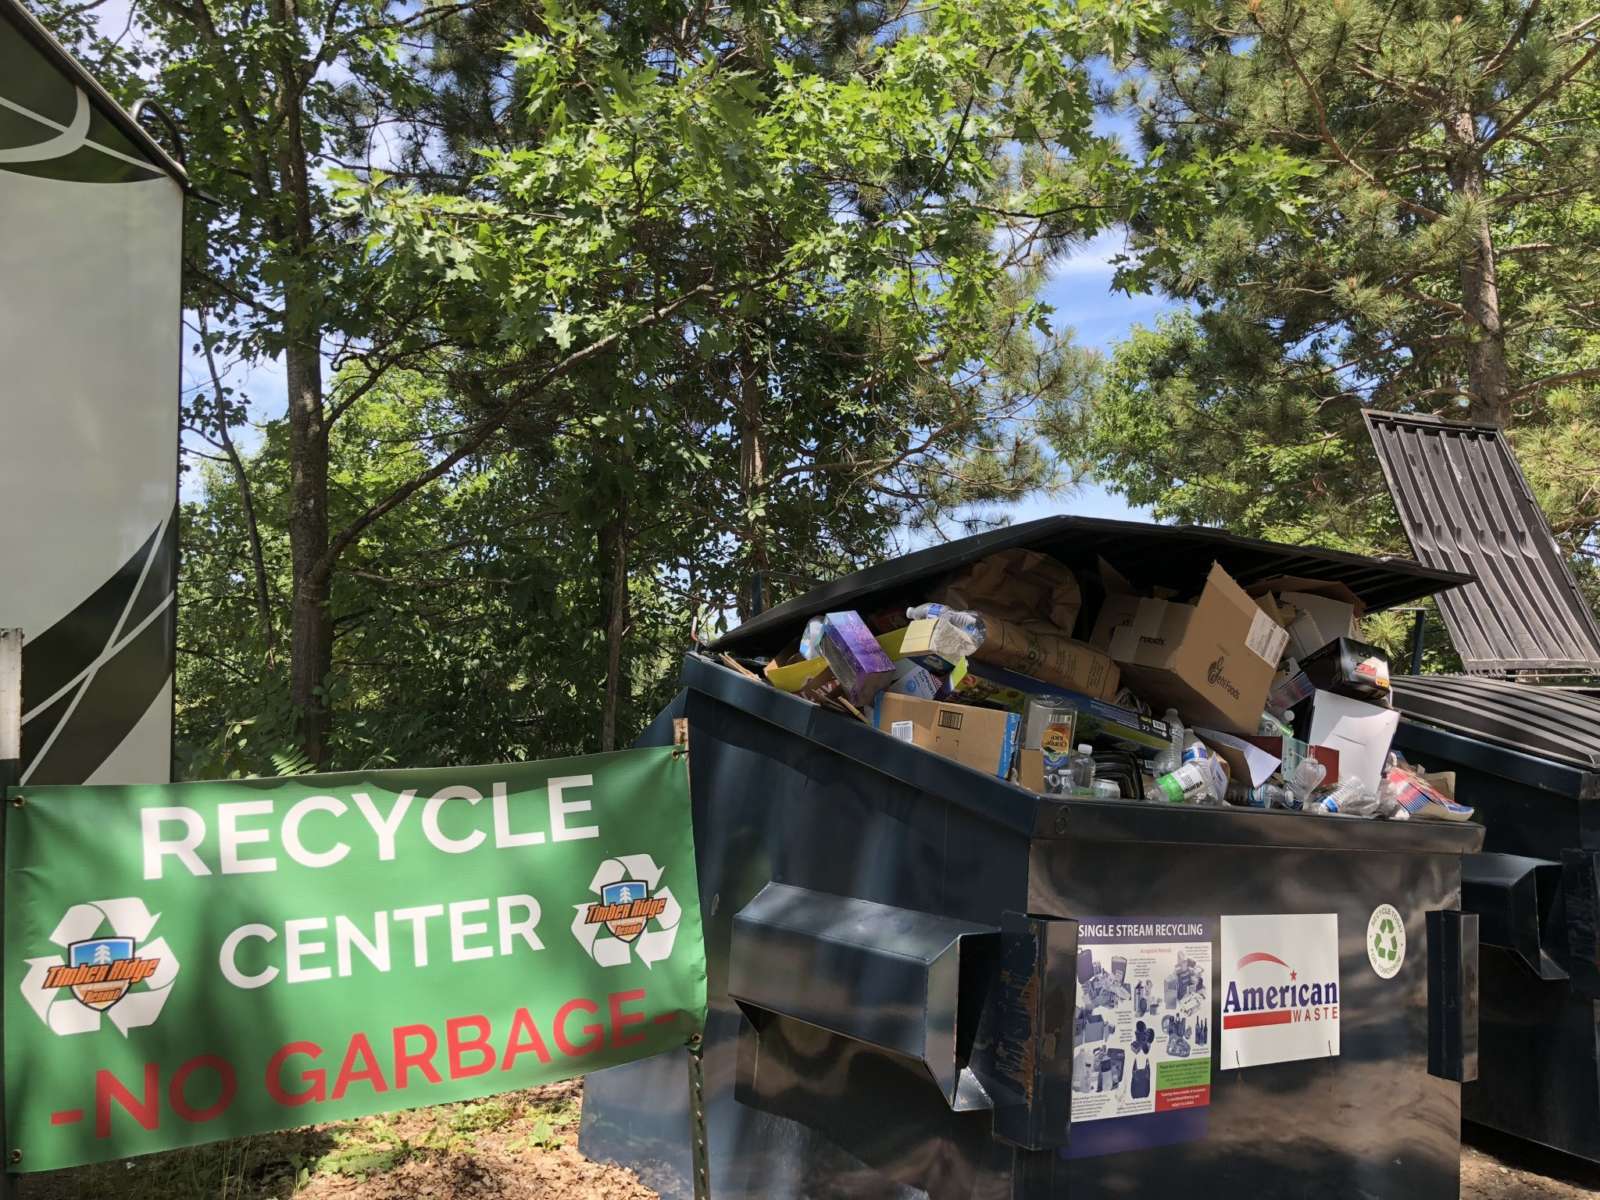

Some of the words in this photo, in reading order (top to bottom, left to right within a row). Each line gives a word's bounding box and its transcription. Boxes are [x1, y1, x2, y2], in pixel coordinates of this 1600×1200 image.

[139, 773, 600, 880] RECYCLE
[584, 902, 632, 925] Timber
[630, 897, 668, 919] Ridge
[220, 894, 545, 989] CENTER
[1078, 924, 1115, 937] SINGLE
[1116, 924, 1154, 937] STREAM
[1155, 923, 1204, 936] RECYCLING
[42, 962, 110, 990] Timber
[107, 957, 161, 984] Ridge
[1223, 980, 1338, 1014] American
[1292, 1006, 1338, 1023] WASTE
[51, 1055, 237, 1138] -NO
